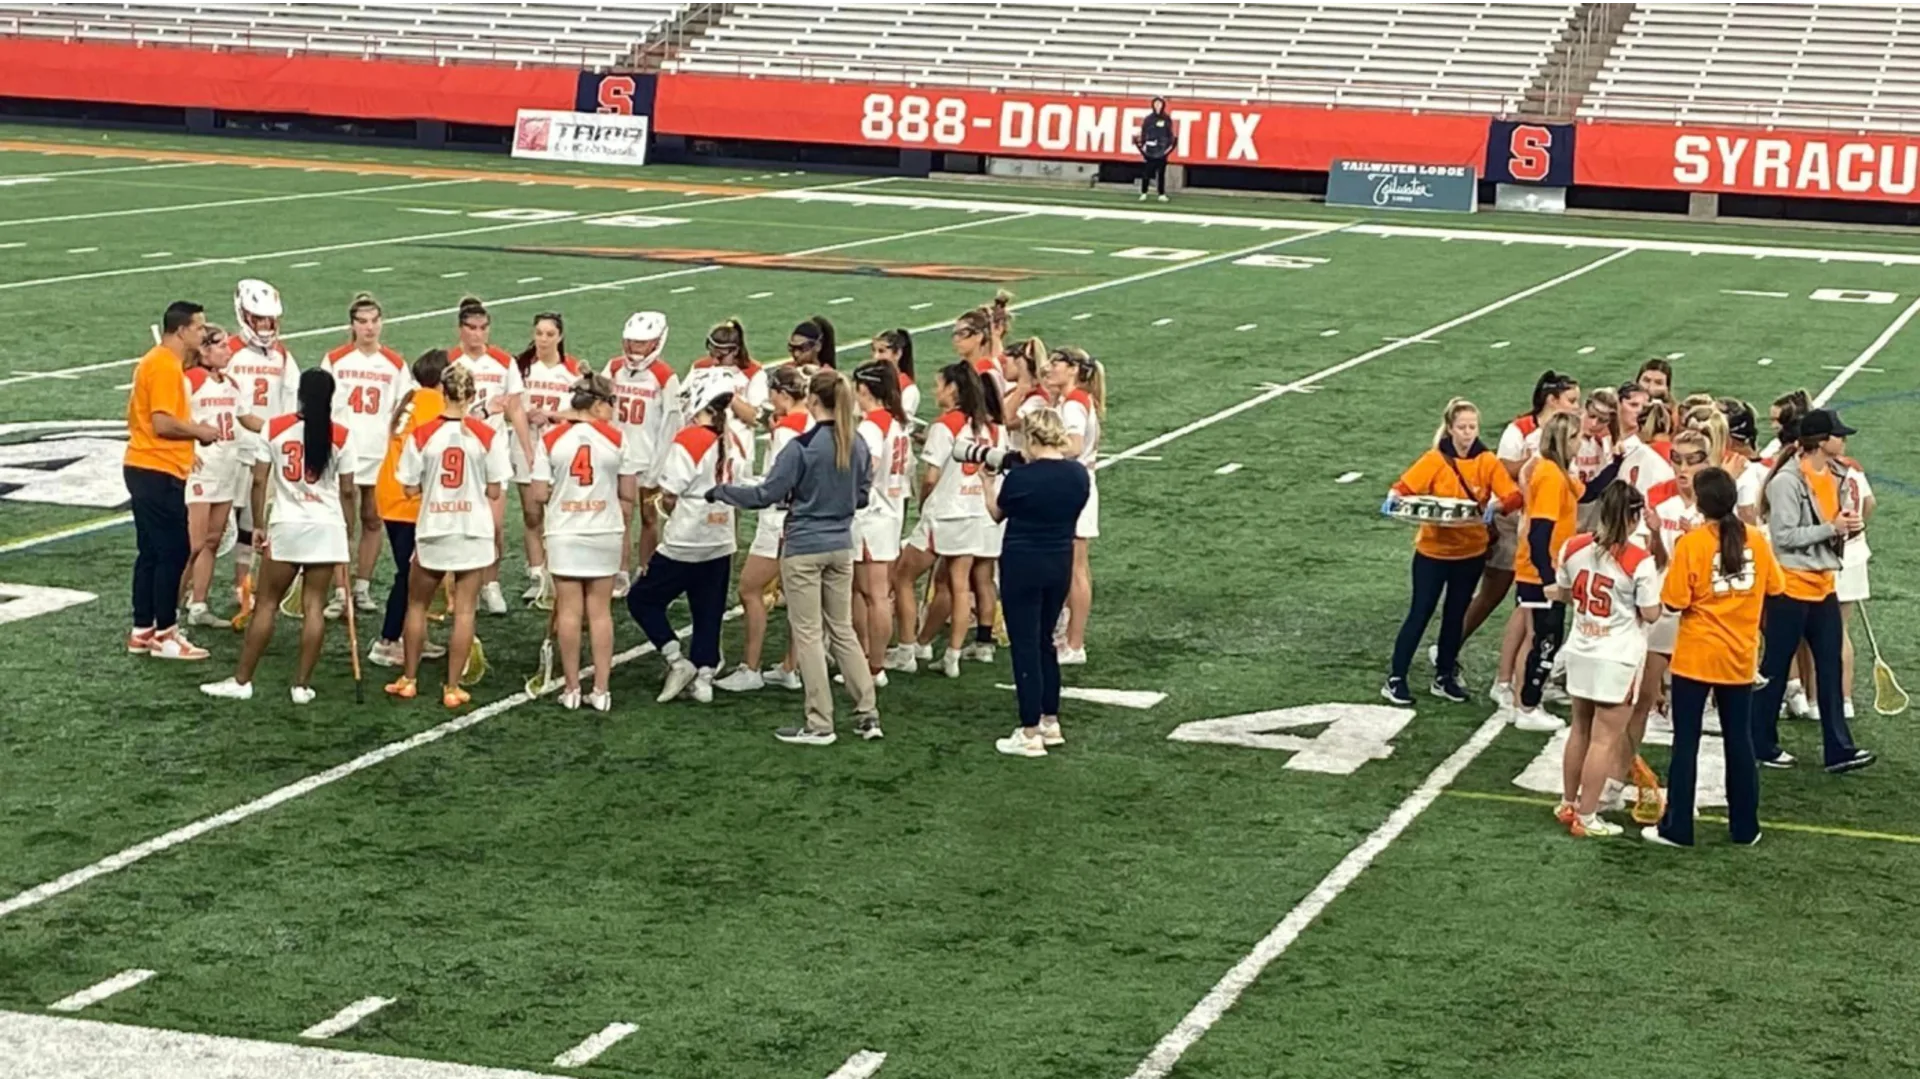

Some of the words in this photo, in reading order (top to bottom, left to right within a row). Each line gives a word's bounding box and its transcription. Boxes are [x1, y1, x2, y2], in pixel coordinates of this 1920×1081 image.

[597, 75, 636, 116] S
[1341, 161, 1417, 175] TAILWATER
[1419, 165, 1465, 177] LODGE
[1507, 125, 1553, 182] S
[1674, 134, 1920, 195] SYRACU
[253, 378, 269, 406] 2
[347, 385, 381, 415] 43
[618, 396, 646, 425] 50
[281, 440, 320, 484] 3
[440, 446, 465, 489] 9
[570, 444, 594, 487] 4
[1571, 568, 1615, 618] 45
[1166, 701, 1417, 775] 4
